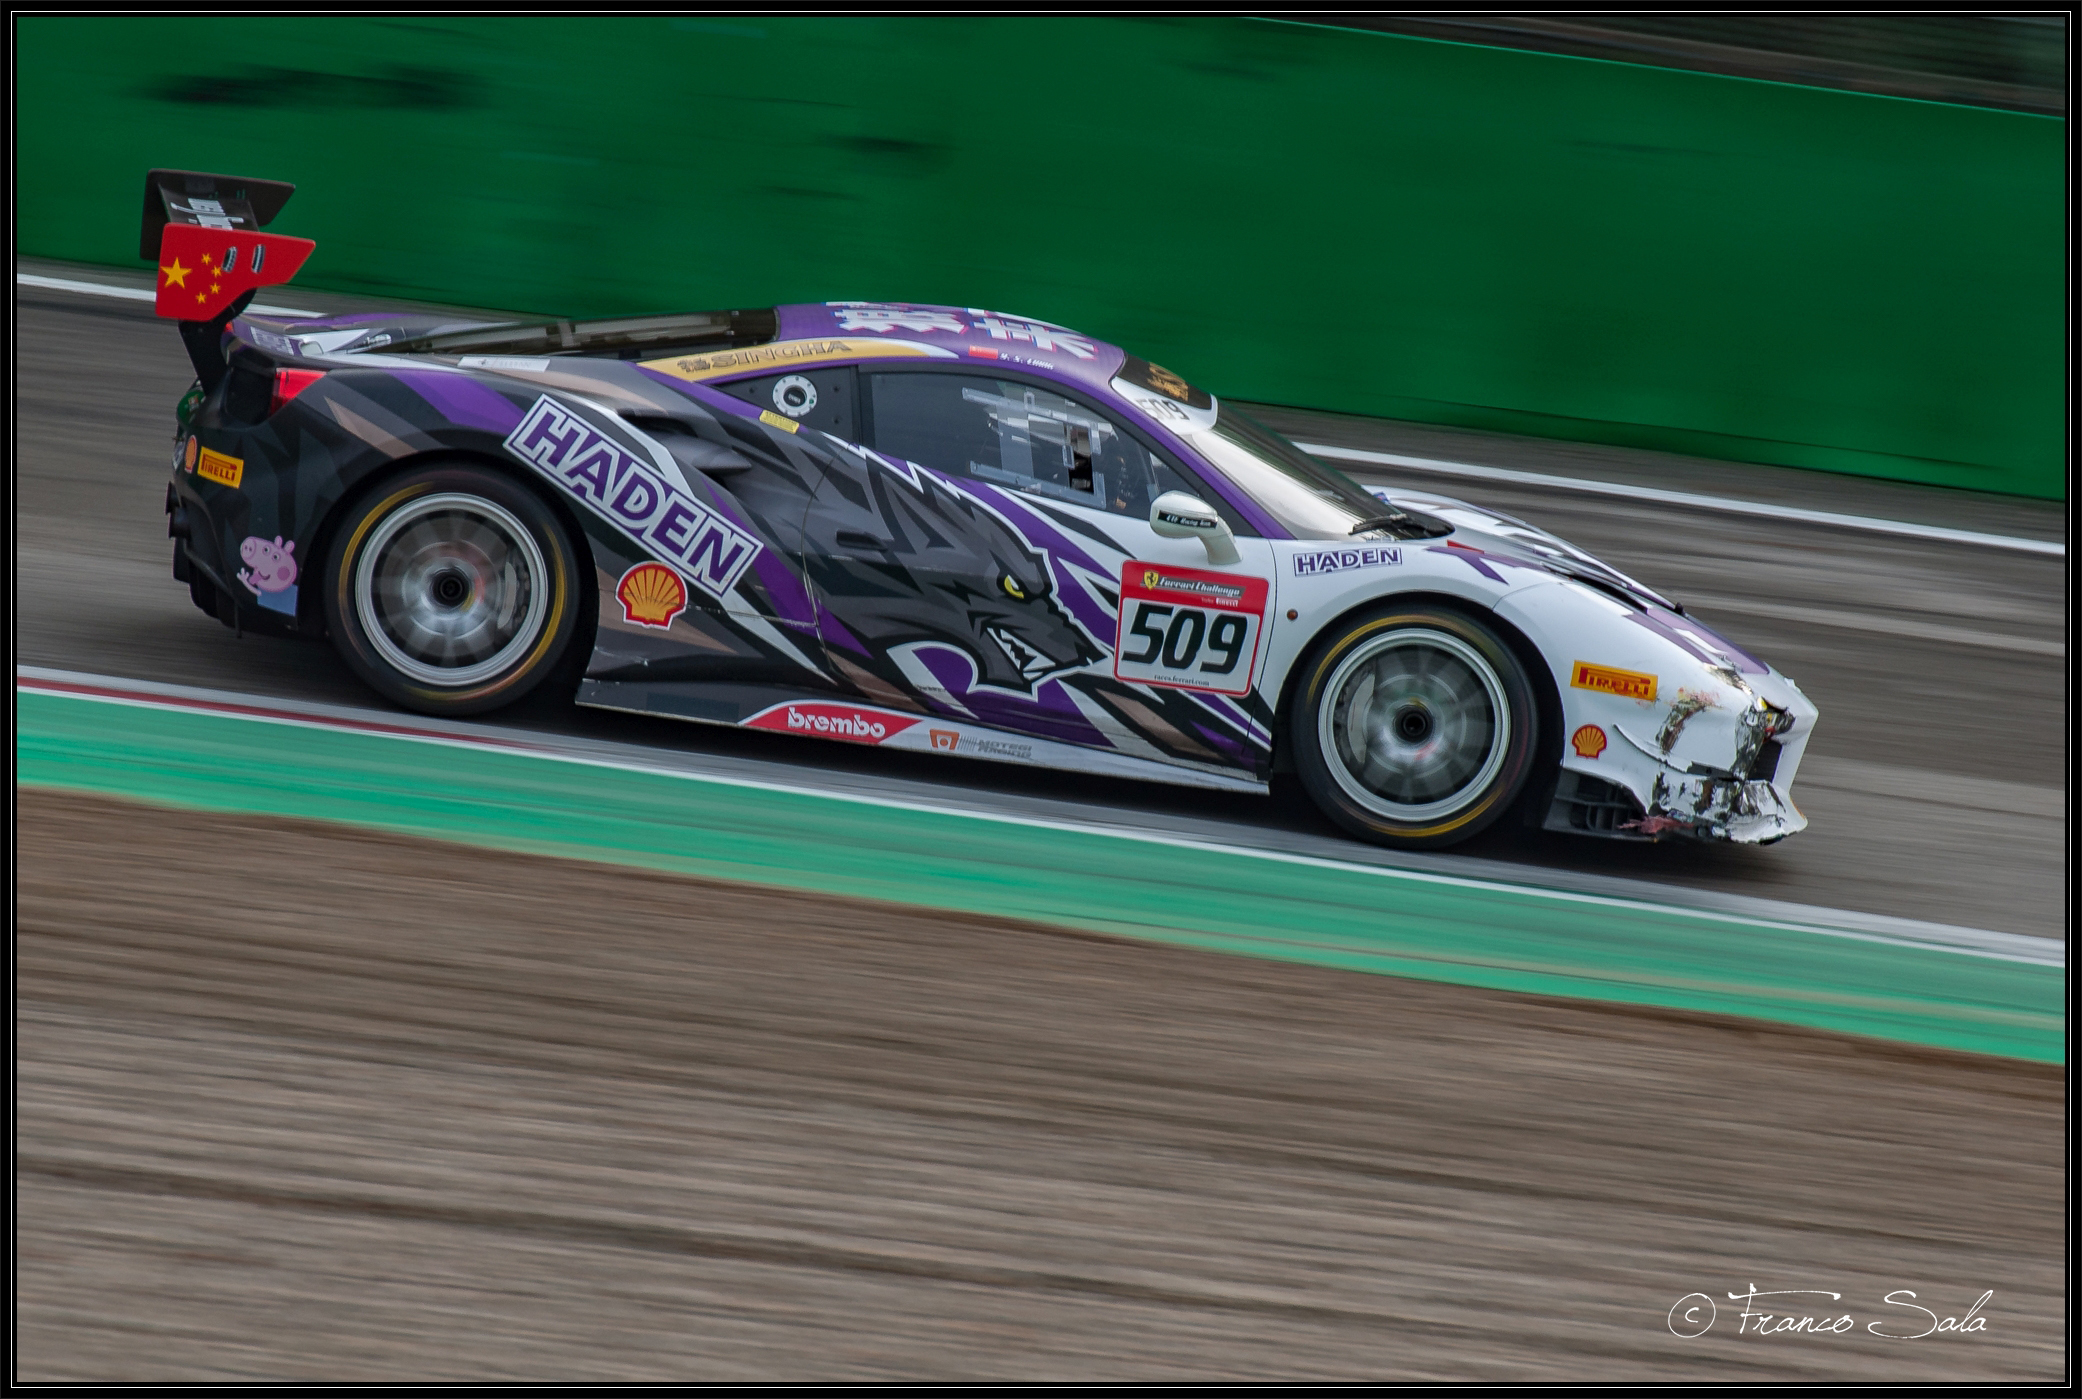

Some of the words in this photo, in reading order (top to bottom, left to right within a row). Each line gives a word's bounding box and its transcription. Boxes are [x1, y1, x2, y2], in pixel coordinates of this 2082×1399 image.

[711, 340, 852, 368] SINGHA
[201, 453, 237, 482] PIRELLI
[515, 403, 753, 593] HADEN
[1294, 548, 1401, 576] HADEN
[1159, 577, 1195, 590] Ferrari
[1195, 582, 1240, 597] Challenge
[1121, 601, 1248, 675] 509
[1578, 666, 1651, 696] PIRELLI
[788, 706, 886, 738] brembo
